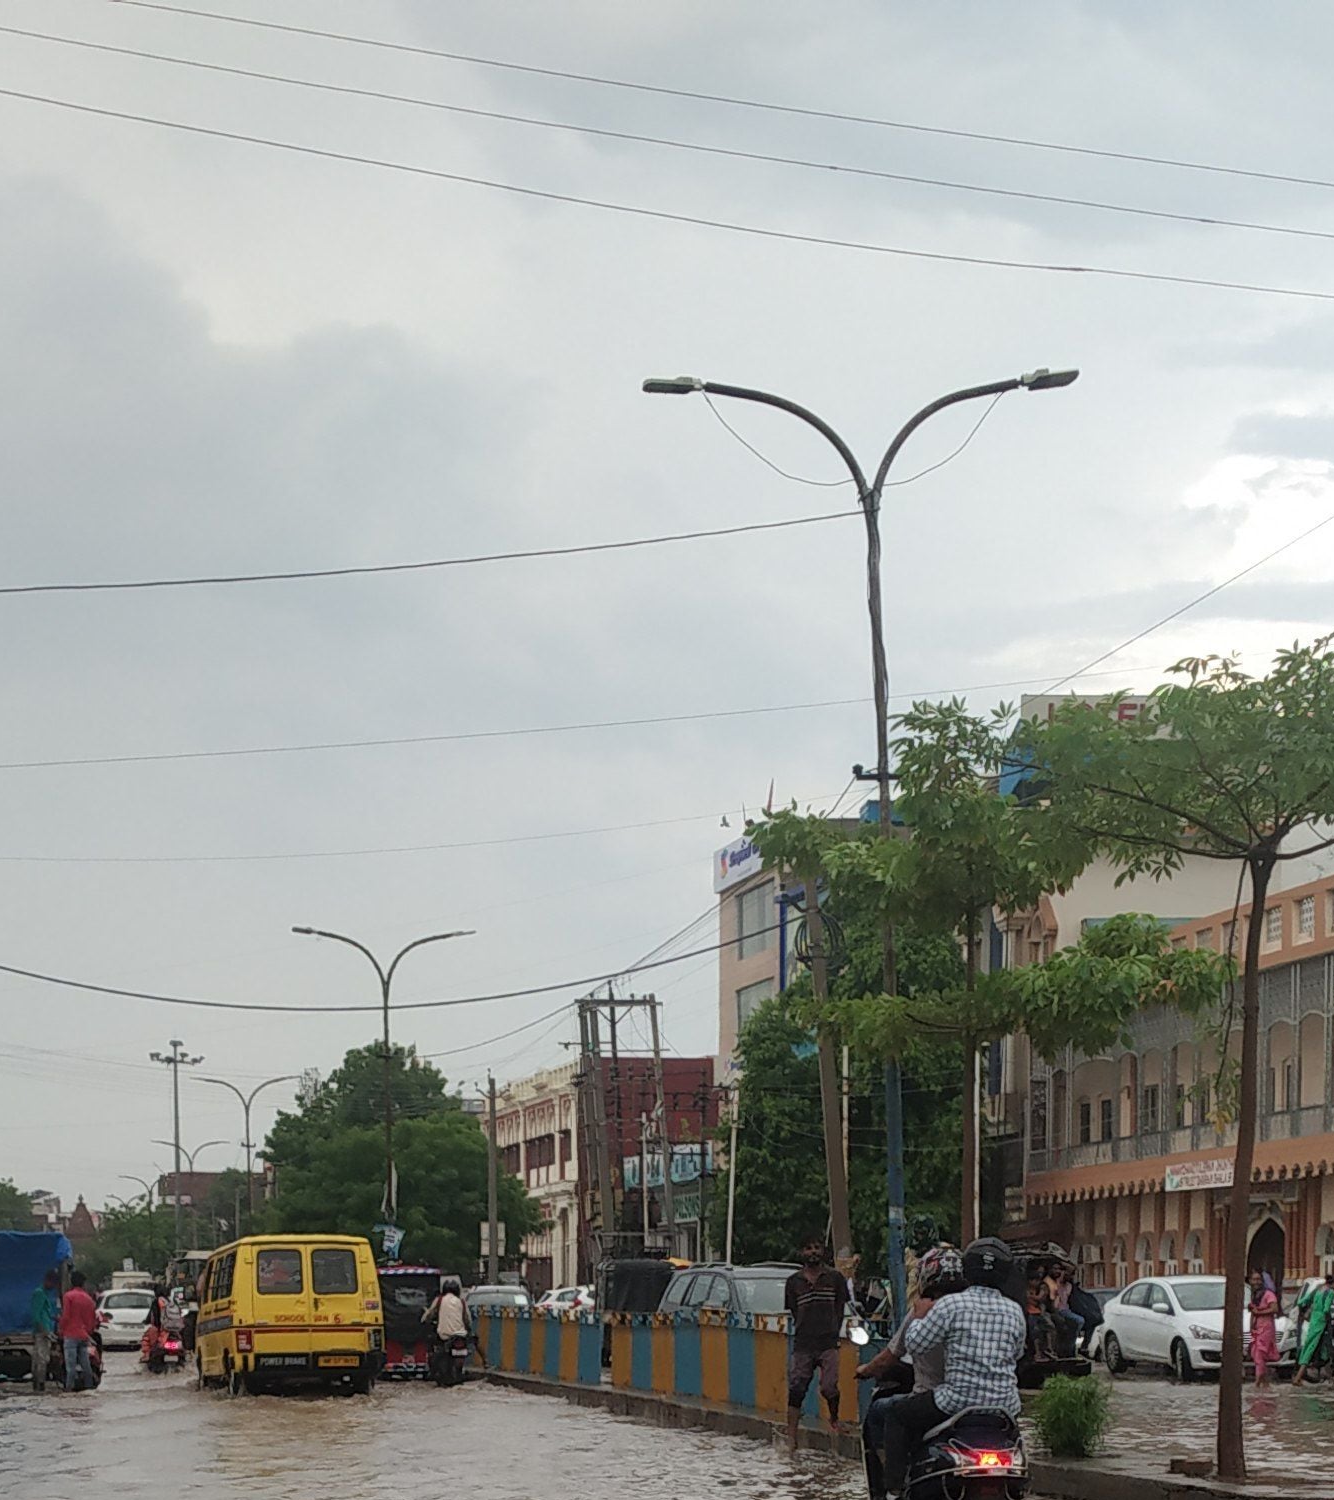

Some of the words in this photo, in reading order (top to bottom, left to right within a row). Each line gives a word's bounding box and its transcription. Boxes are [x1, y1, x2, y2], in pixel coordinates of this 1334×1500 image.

[274, 1314, 306, 1322] SCHOOL
[260, 1357, 283, 1366] POWER
[284, 1356, 307, 1365] BRAKE
